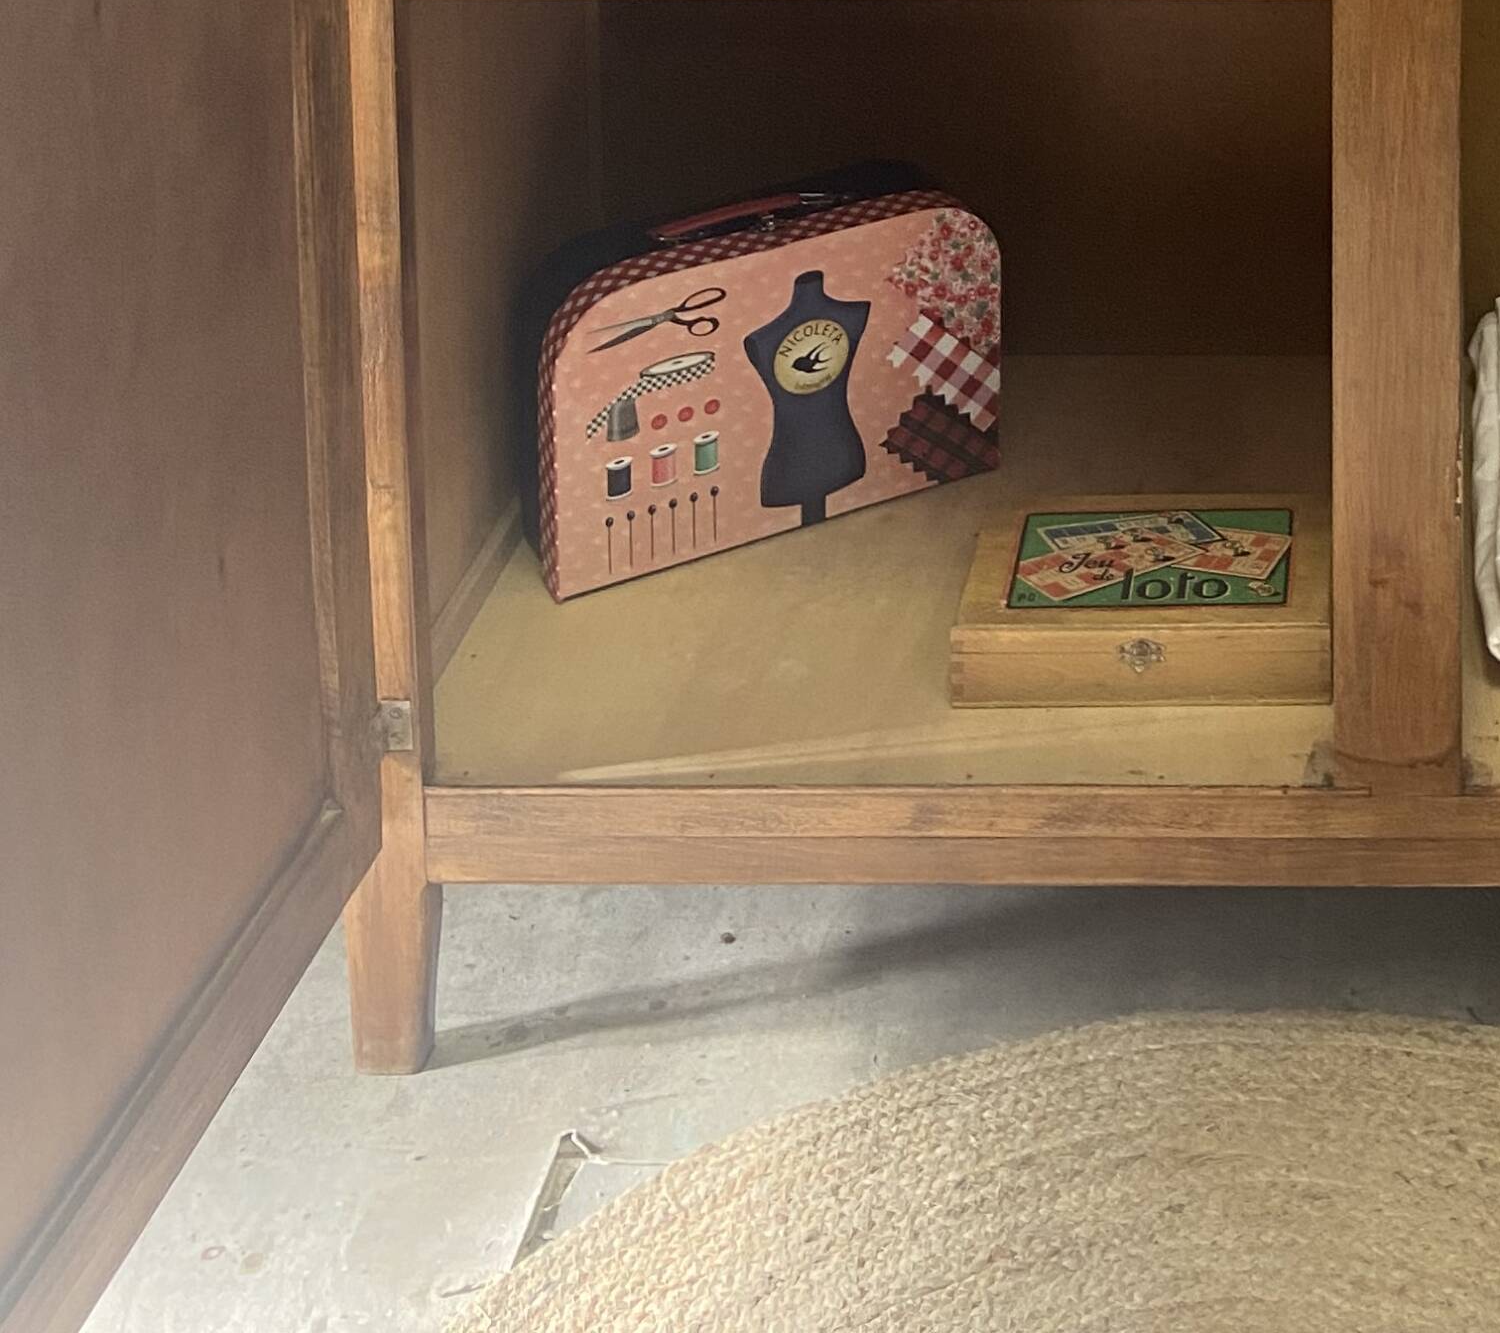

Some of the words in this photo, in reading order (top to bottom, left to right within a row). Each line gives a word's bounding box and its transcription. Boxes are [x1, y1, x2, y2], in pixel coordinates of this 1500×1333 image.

[779, 323, 843, 357] NICOLETA
[1059, 552, 1114, 574] Jeu
[1093, 568, 1114, 582] de
[1121, 568, 1230, 601] loto
